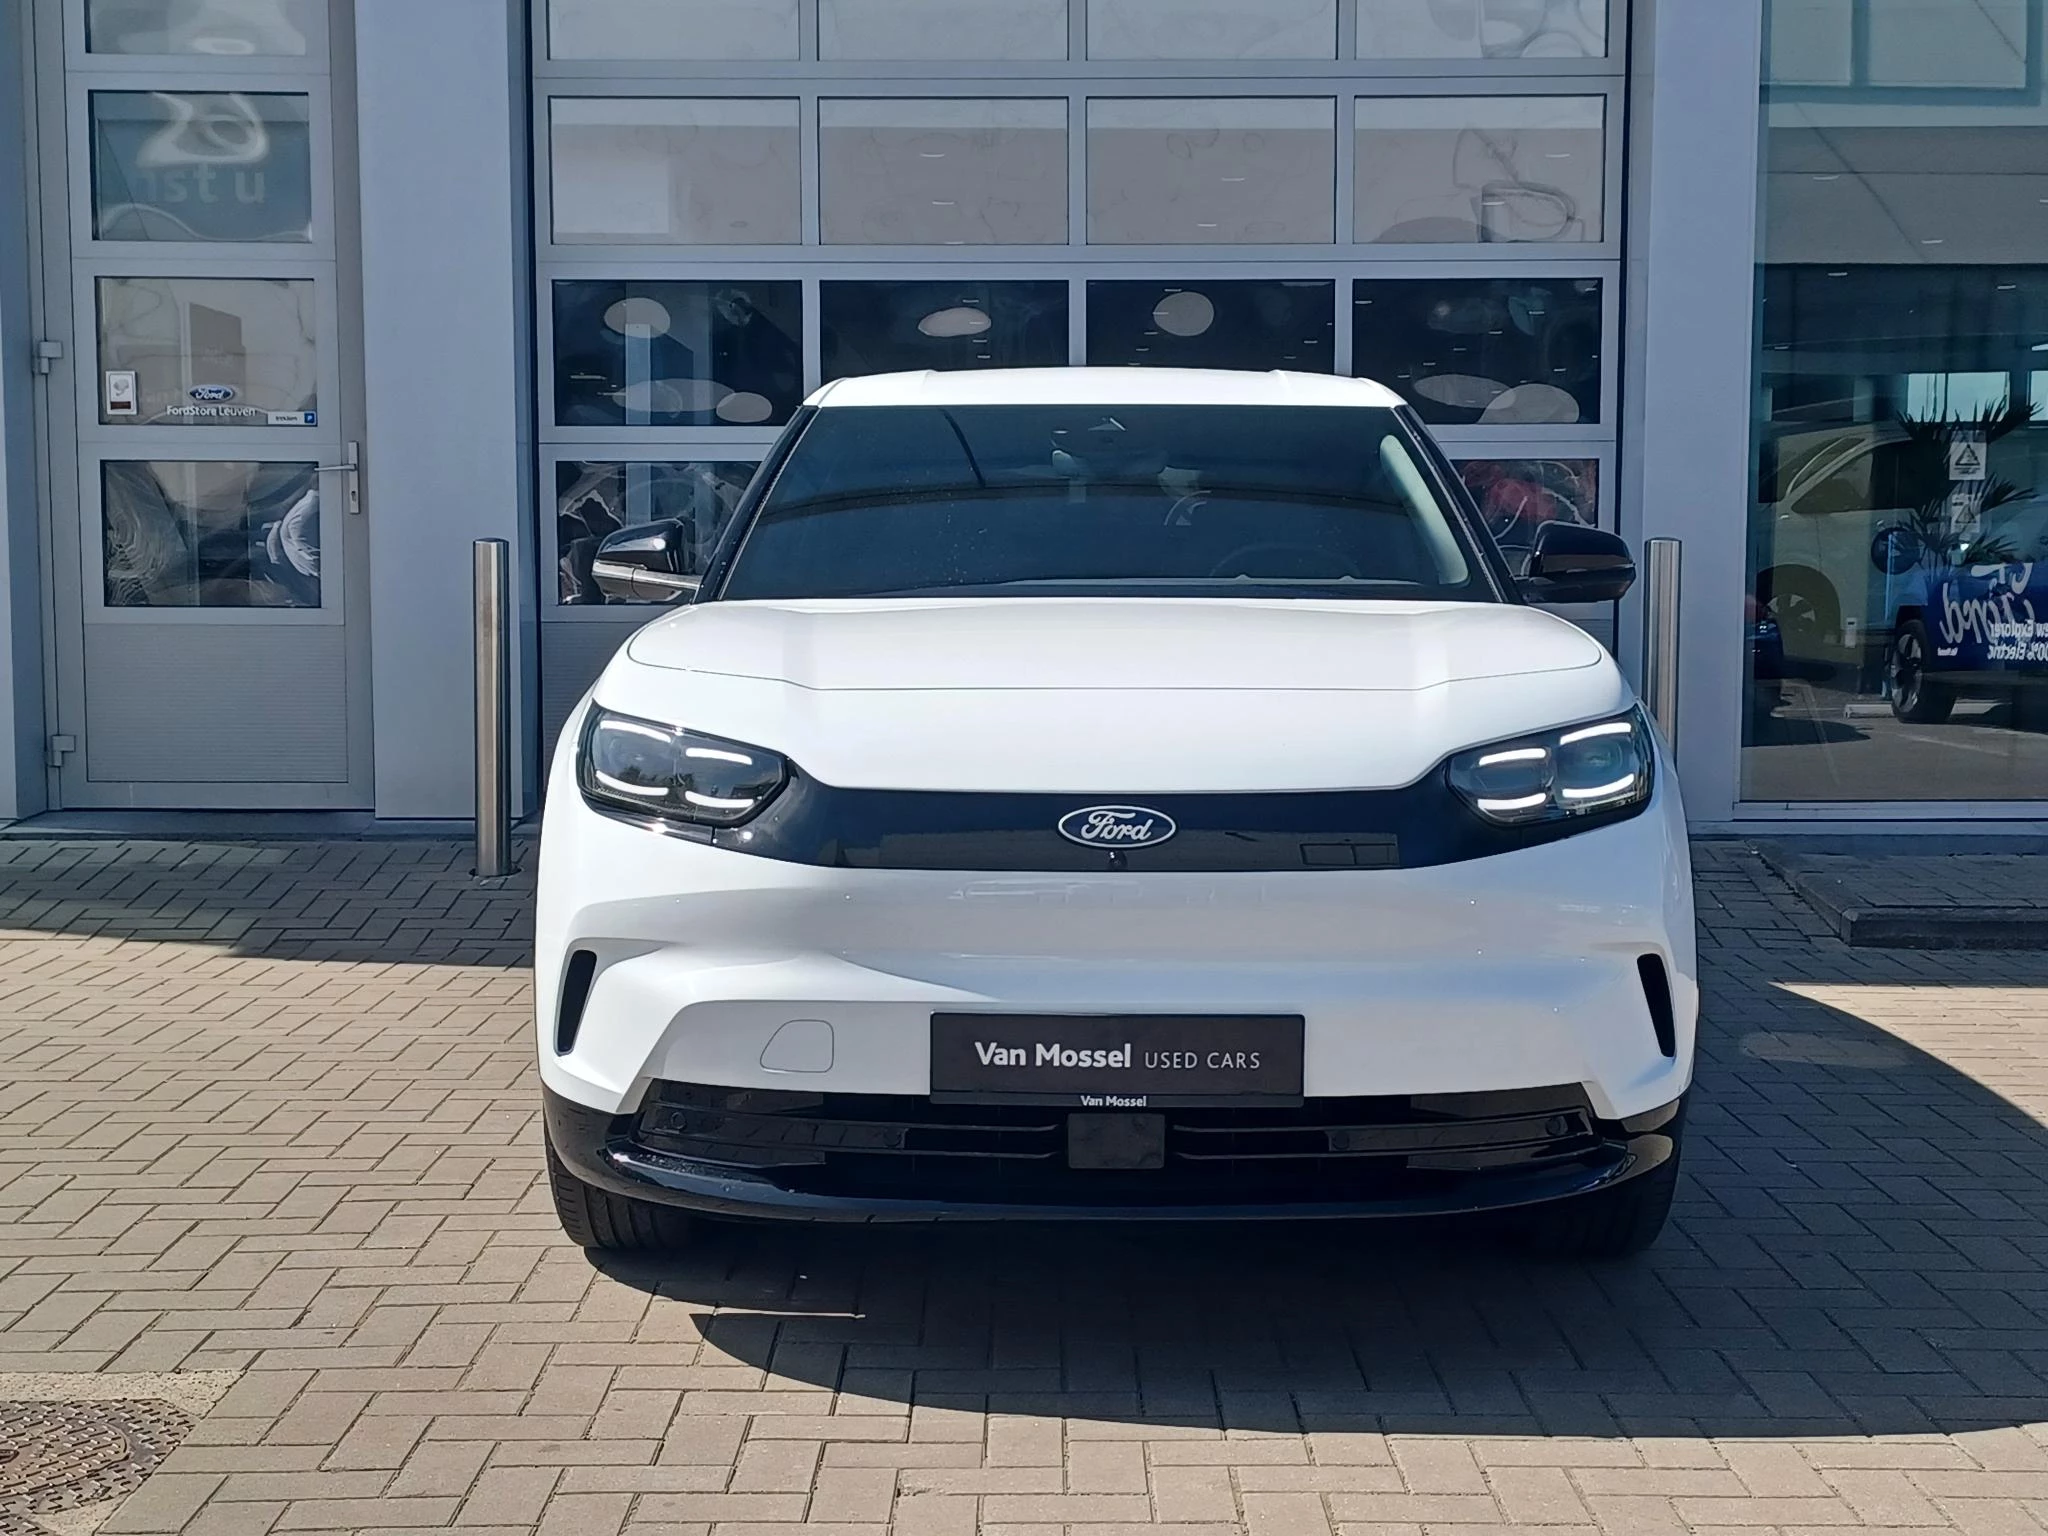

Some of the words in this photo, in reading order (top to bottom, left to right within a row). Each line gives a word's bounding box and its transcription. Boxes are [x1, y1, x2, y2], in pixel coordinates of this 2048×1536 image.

[167, 405, 216, 417] FordStore
[219, 405, 256, 417] Leuven
[1081, 810, 1154, 841] Ford
[974, 1041, 1027, 1066] Van
[1035, 1043, 1131, 1068] Mossel
[1145, 1052, 1198, 1069] USED
[1207, 1052, 1261, 1070] CARS
[1080, 1095, 1103, 1106] Van
[1106, 1095, 1147, 1107] Mossel
